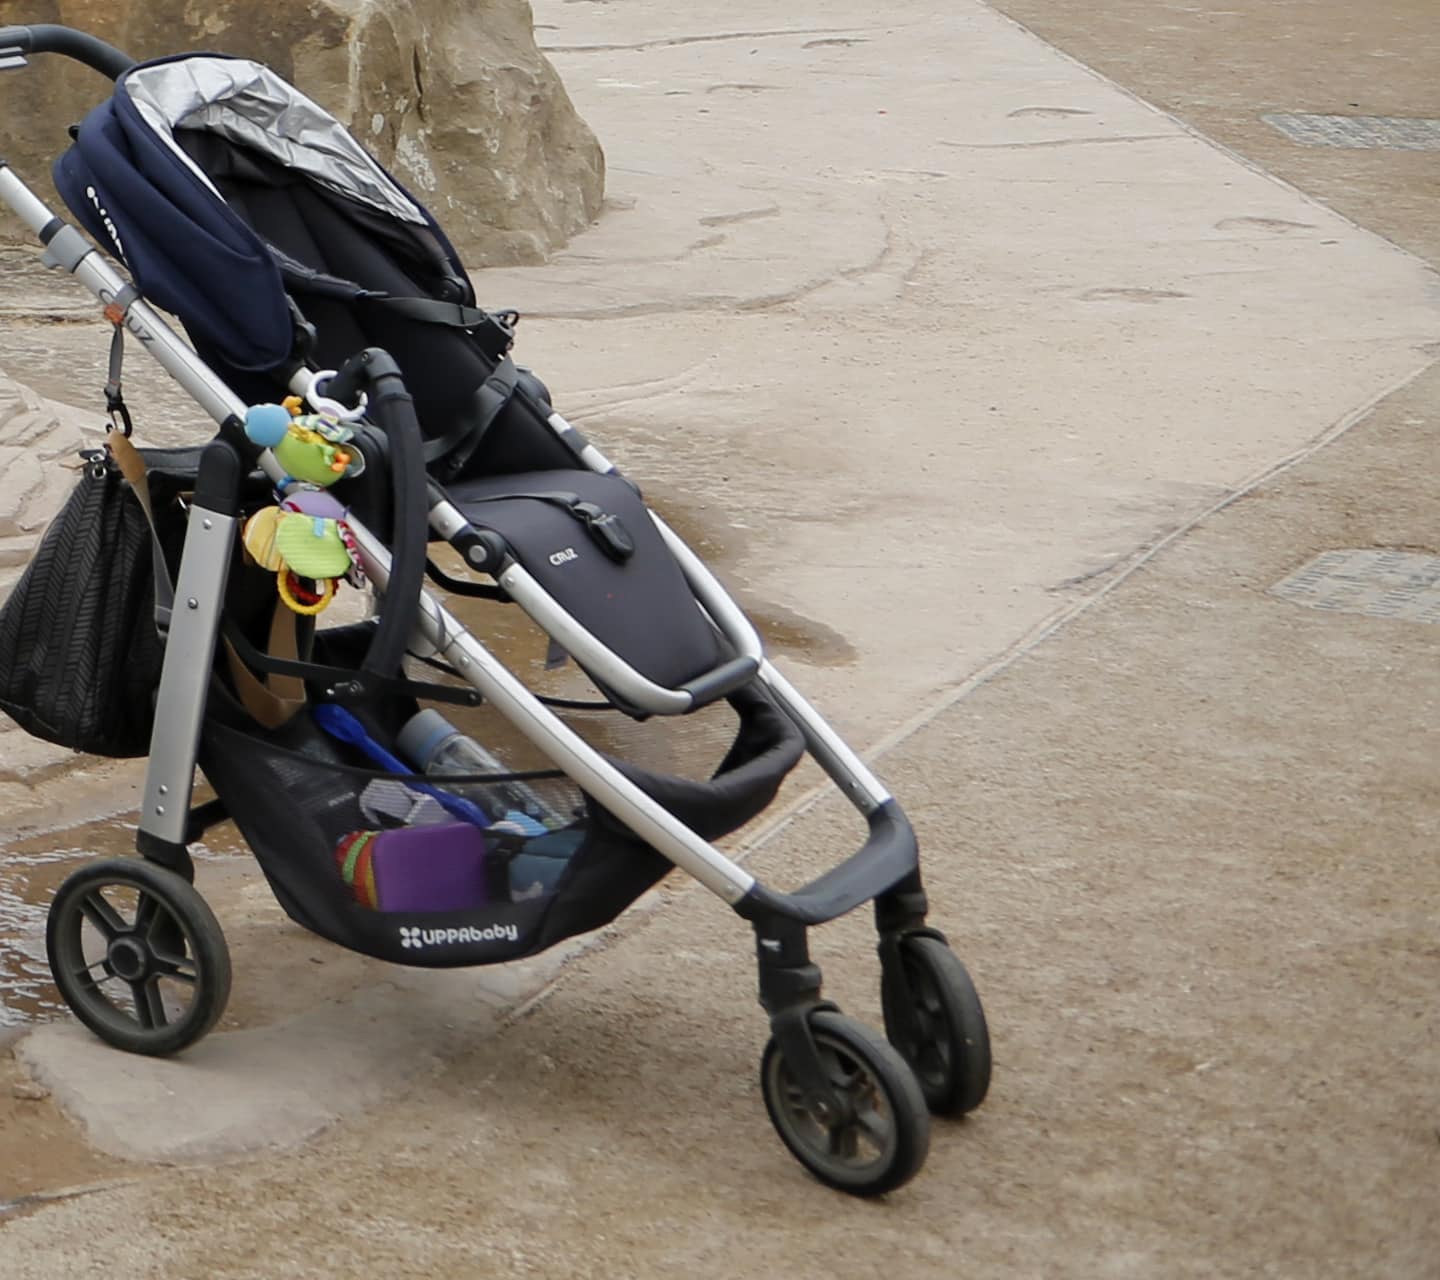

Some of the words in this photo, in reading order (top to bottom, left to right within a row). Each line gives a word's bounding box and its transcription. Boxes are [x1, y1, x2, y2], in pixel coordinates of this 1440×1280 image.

[98, 288, 156, 348] CUZ
[549, 547, 579, 566] CRUZ
[421, 922, 519, 945] UPPAbaby
